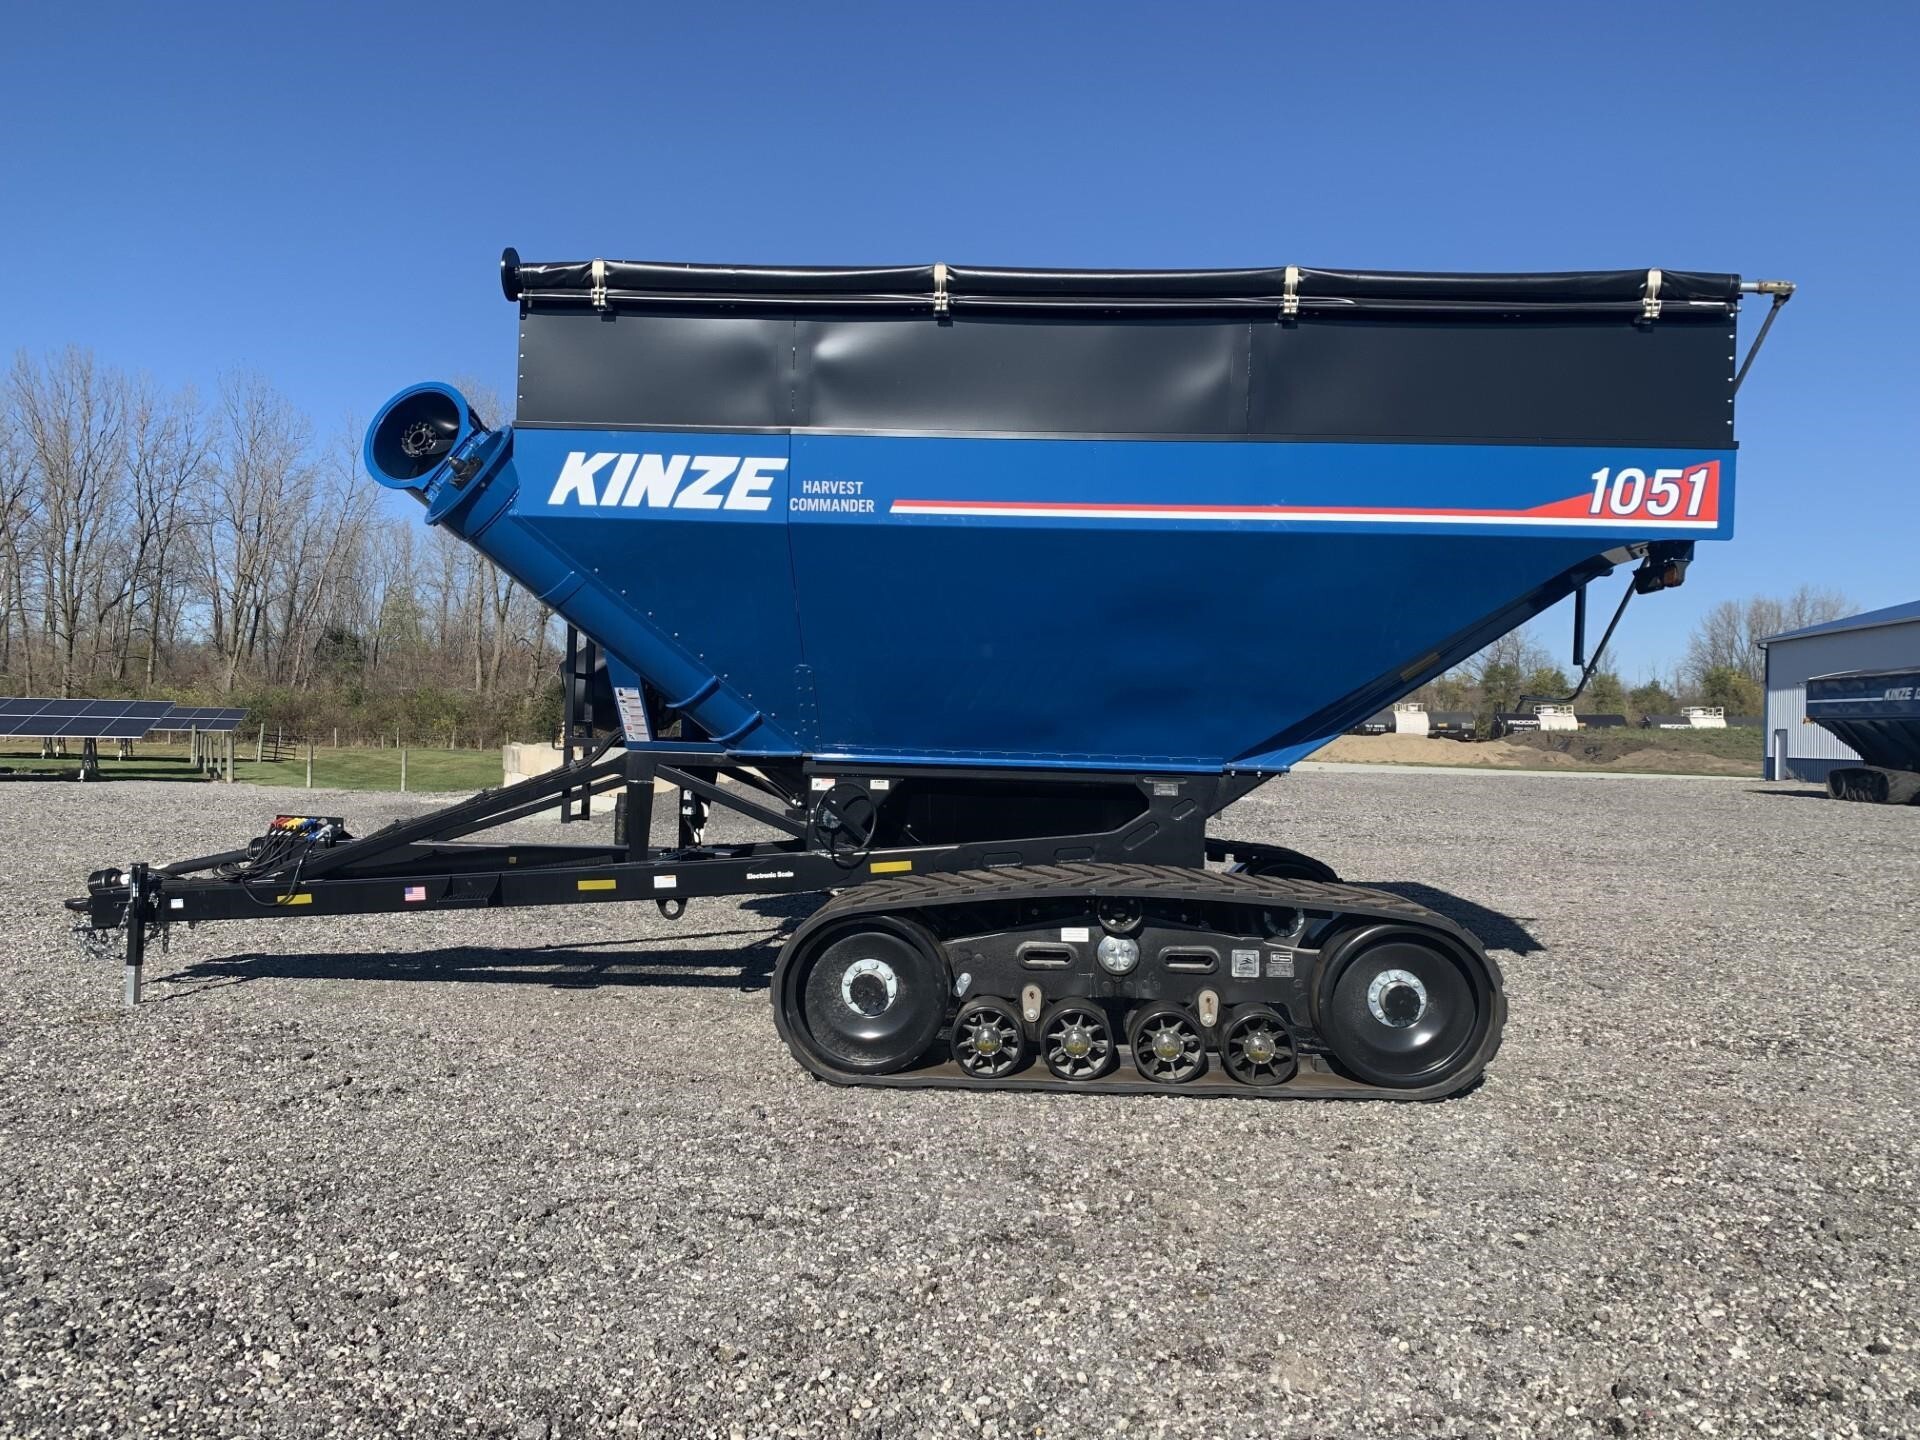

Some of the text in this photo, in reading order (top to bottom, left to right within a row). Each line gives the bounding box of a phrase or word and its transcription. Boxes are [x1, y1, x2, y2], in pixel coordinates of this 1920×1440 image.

[547, 451, 789, 511] KINZE
[802, 480, 865, 495] HARVEST
[1589, 467, 1708, 516] 1051
[789, 498, 875, 513] COMMANDER
[1884, 687, 1914, 701] KINZE
[746, 872, 776, 880] Electronic
